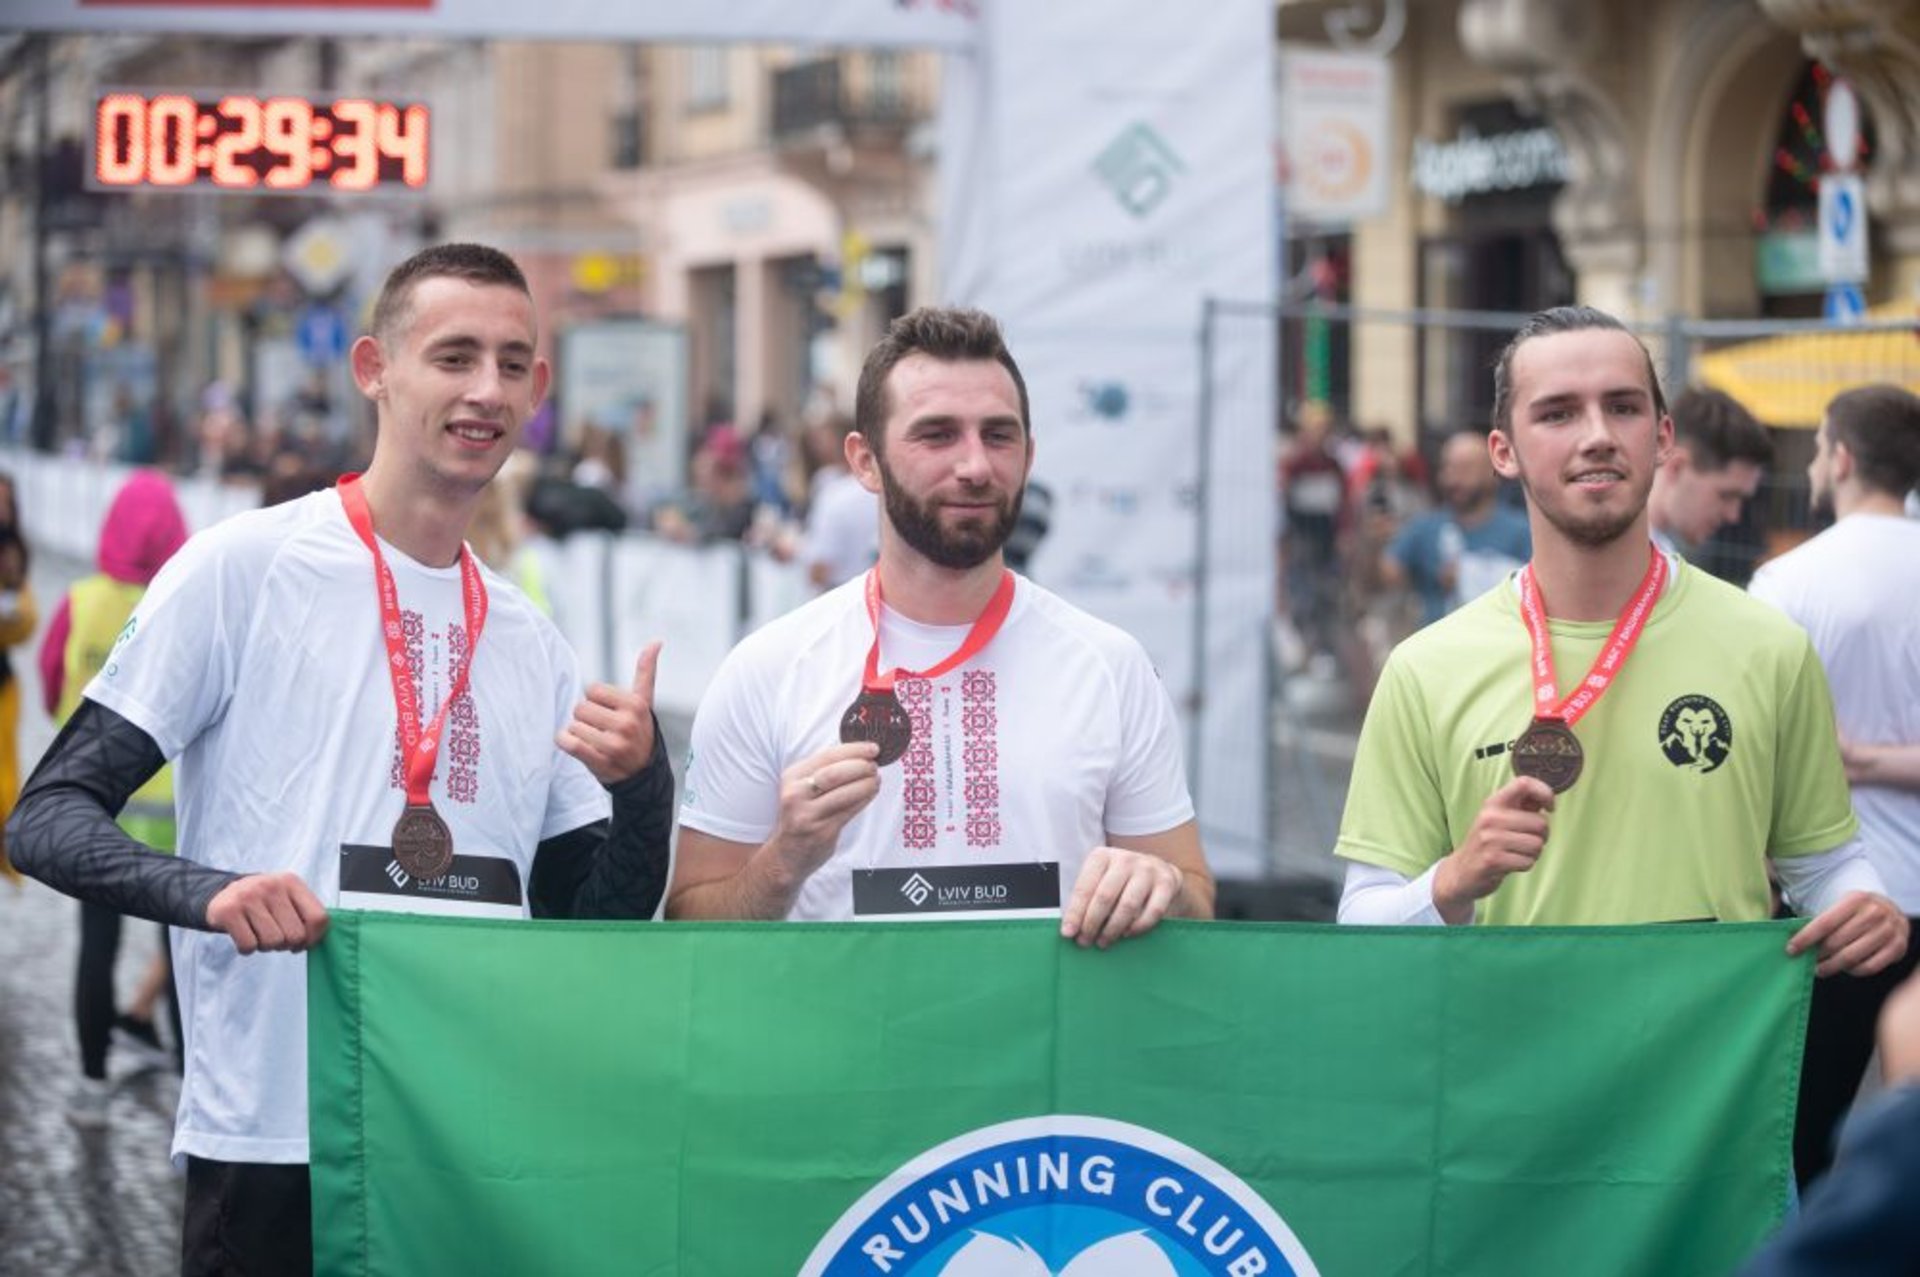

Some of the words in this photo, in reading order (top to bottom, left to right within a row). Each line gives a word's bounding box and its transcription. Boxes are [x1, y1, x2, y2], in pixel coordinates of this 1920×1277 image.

[97, 94, 428, 188] 00:29:34
[397, 674, 411, 708] LVIV
[403, 711, 417, 746] BUD
[449, 875, 479, 890] BUD
[938, 886, 971, 900] LVIV
[975, 885, 1007, 900] BUD
[862, 1152, 1116, 1273] RUNNING
[1145, 1177, 1267, 1277] CLUB
